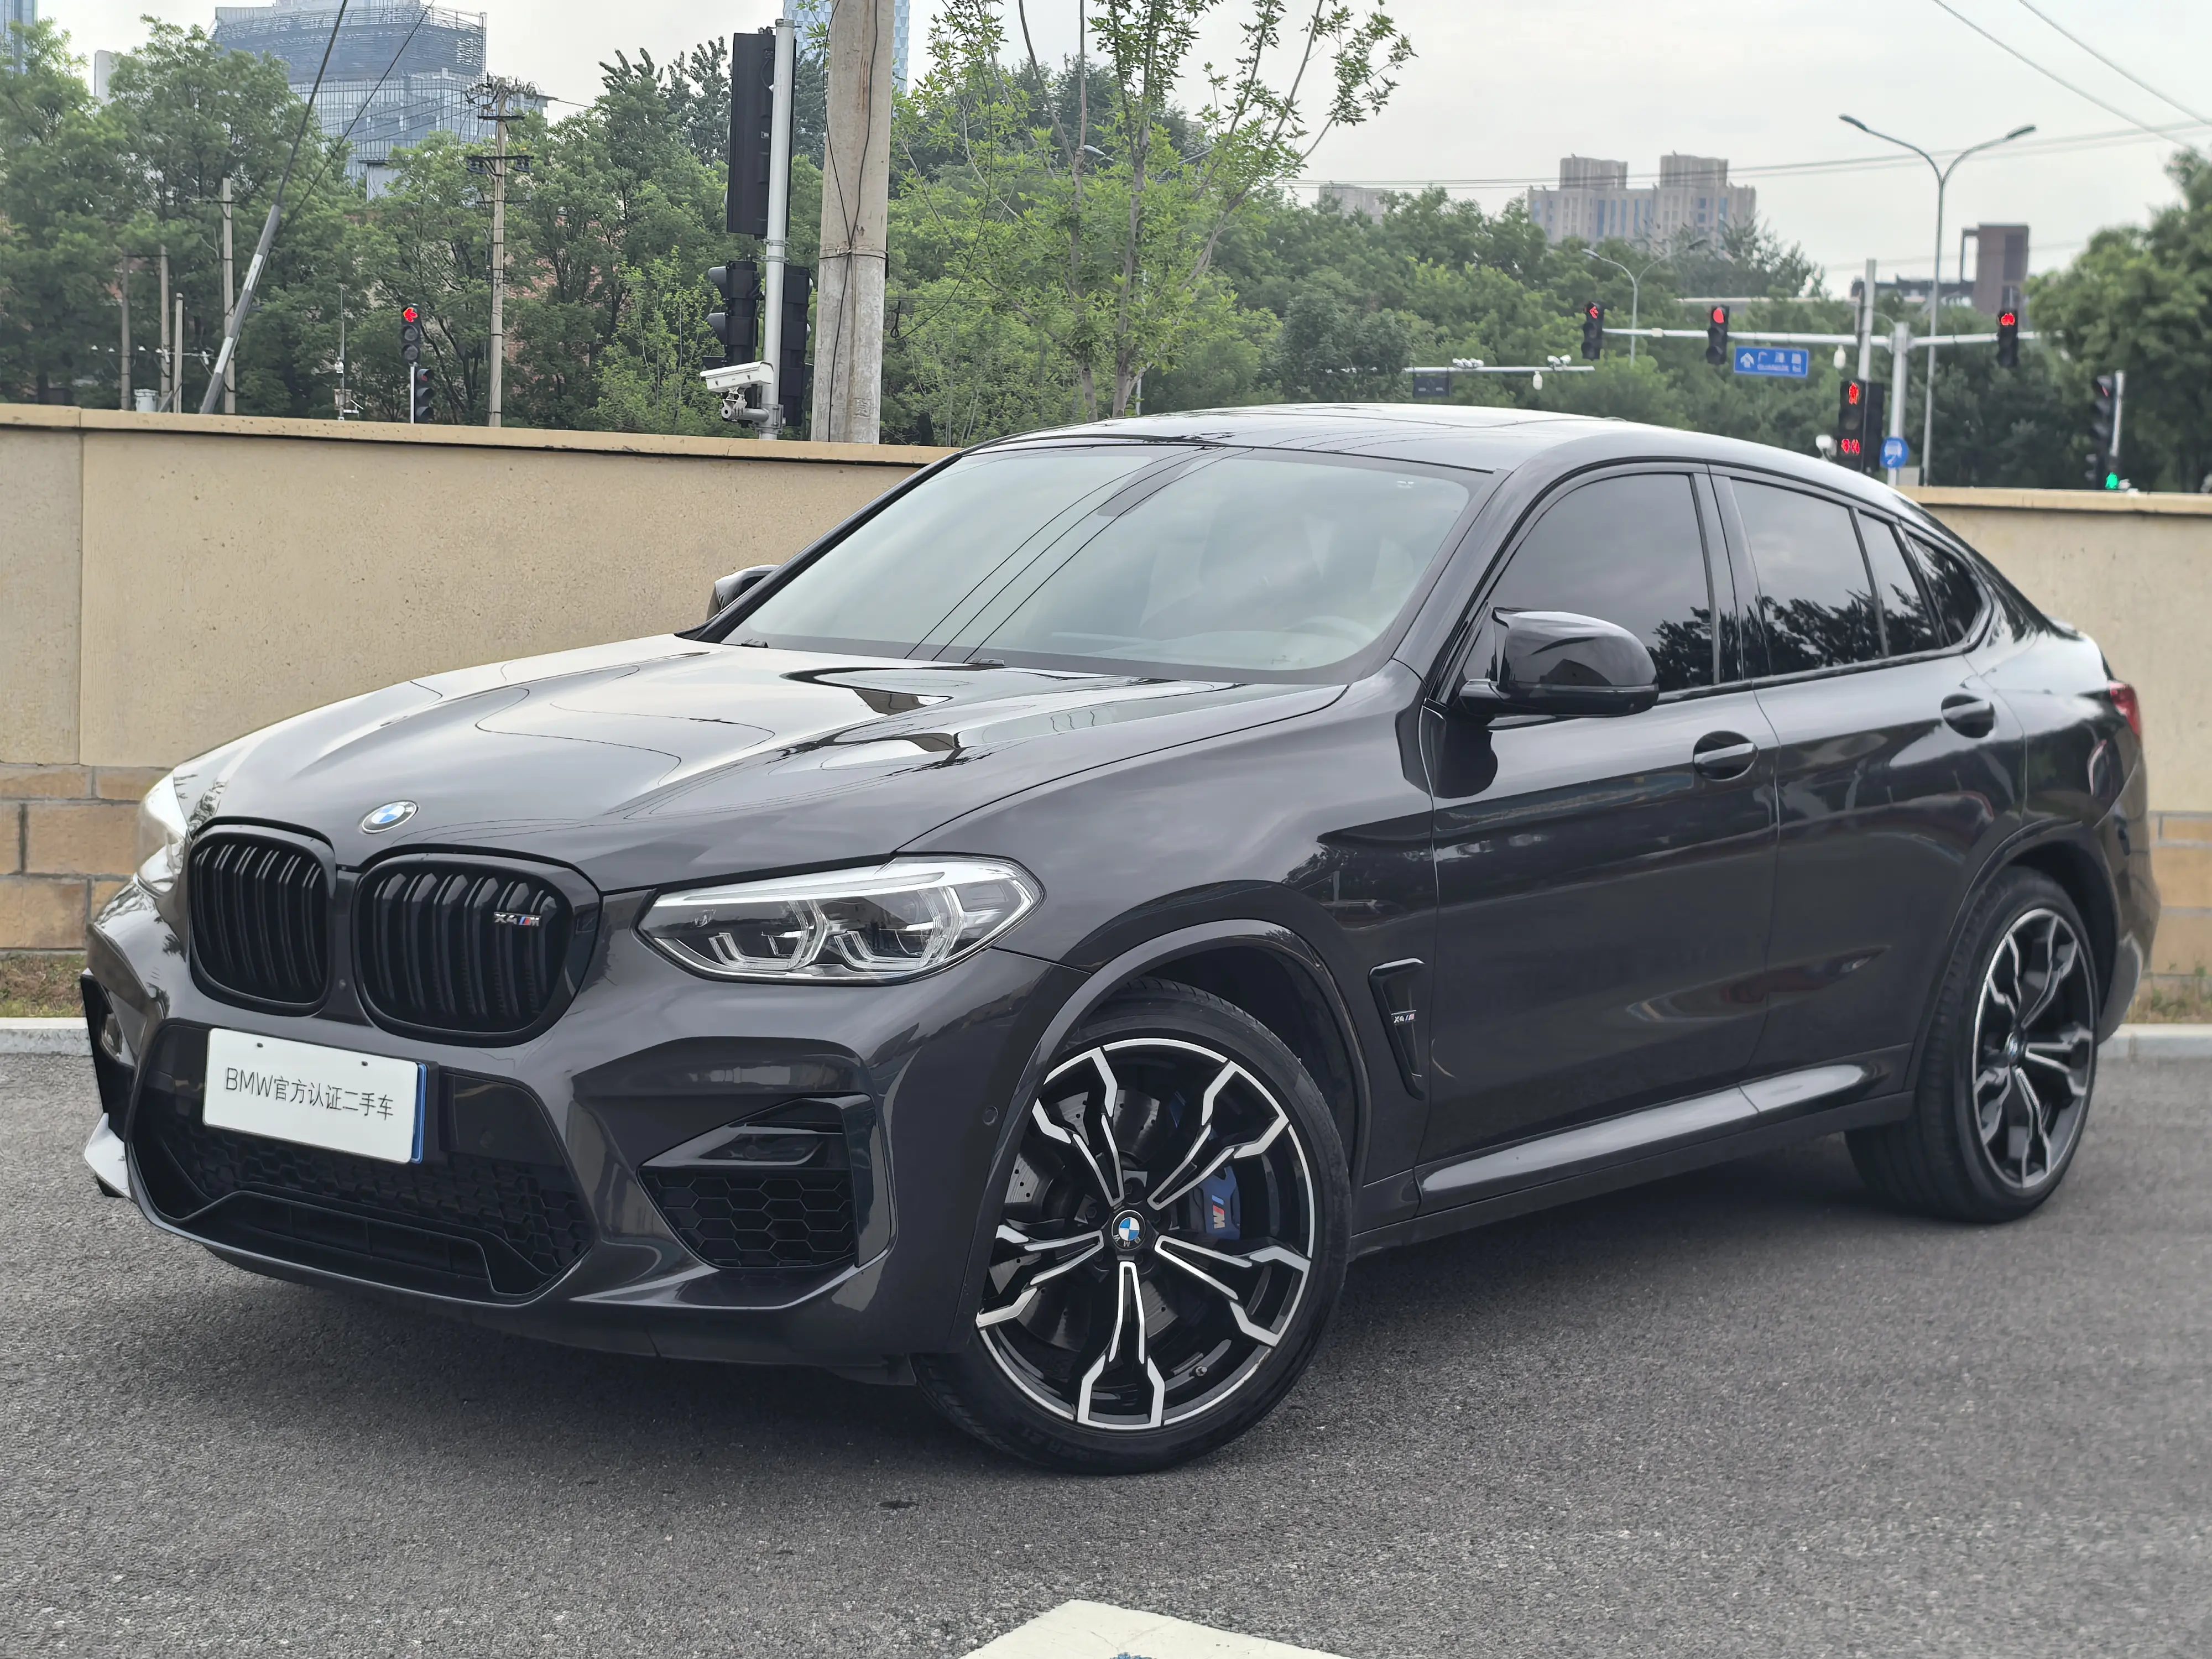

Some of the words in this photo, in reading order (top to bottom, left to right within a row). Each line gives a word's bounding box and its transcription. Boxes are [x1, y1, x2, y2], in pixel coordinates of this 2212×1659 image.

[226, 1067, 394, 1120] BMW官方认证二手车
